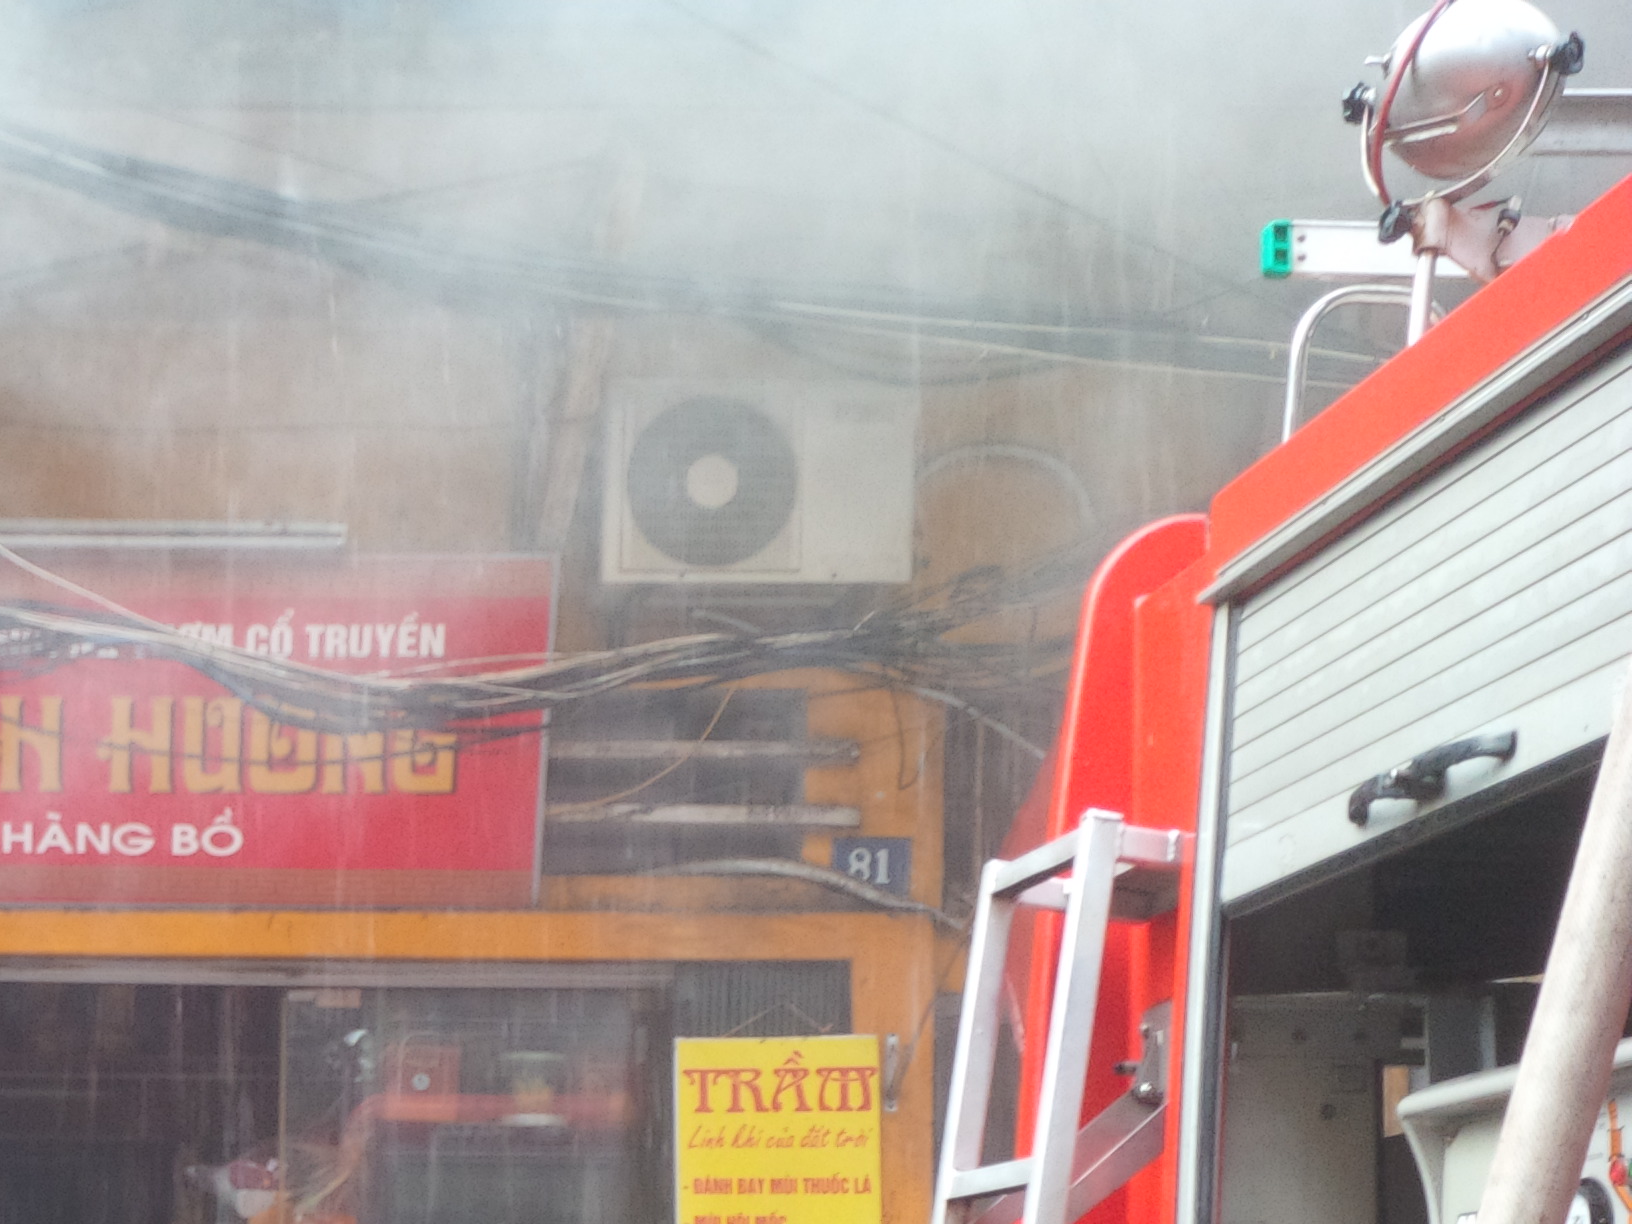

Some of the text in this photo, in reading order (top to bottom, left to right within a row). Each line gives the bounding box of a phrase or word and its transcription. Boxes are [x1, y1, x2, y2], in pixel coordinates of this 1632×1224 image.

[246, 607, 294, 657] CỔ
[0, 810, 157, 857] HÀNG
[170, 806, 245, 858] BỔ
[848, 846, 892, 885] 81
